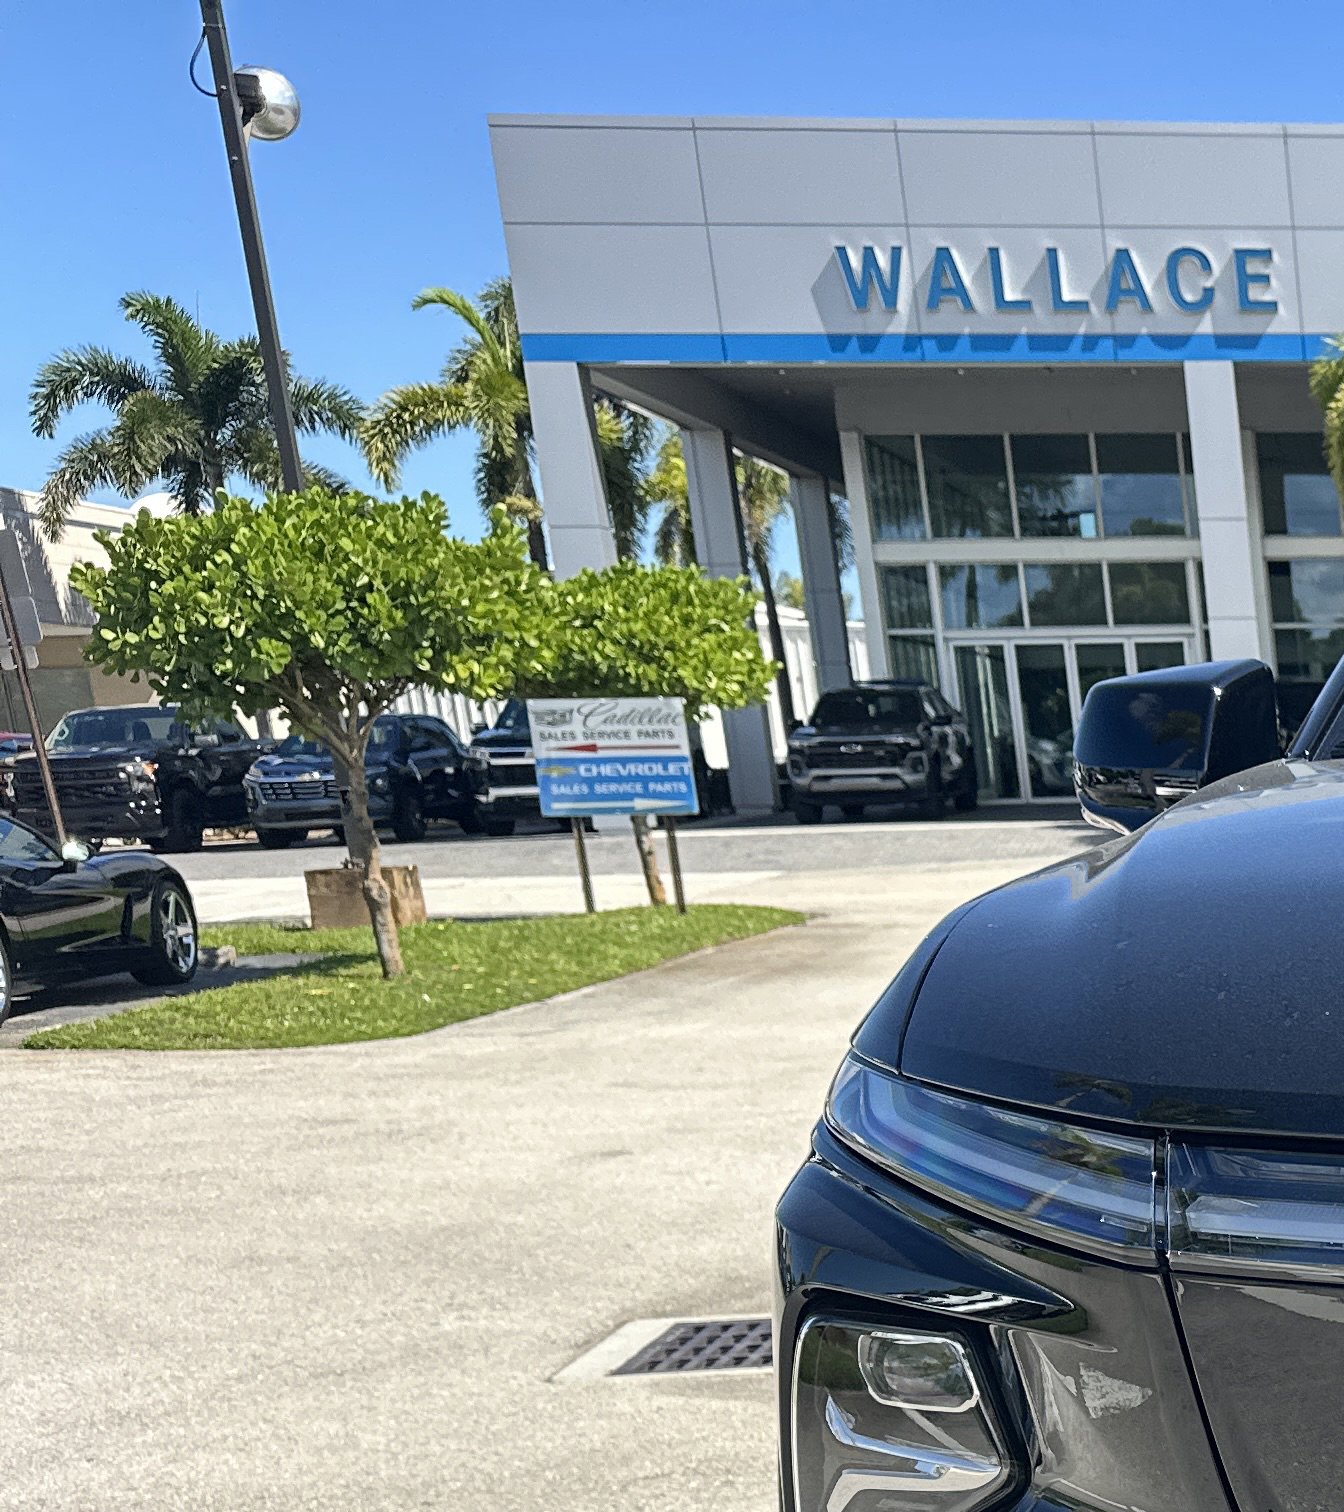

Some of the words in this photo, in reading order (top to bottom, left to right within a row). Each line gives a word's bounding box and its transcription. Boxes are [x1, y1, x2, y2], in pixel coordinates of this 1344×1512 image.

[834, 246, 1278, 313] WALLACE
[577, 702, 682, 730] Cadillac
[539, 730, 577, 741] SALES
[582, 729, 632, 740] SERVICE
[637, 728, 675, 740] PARTS
[578, 761, 690, 777] CHEVROLET
[550, 783, 590, 795] SALES
[594, 782, 644, 794] SERVICE
[649, 781, 688, 793] PARTS
